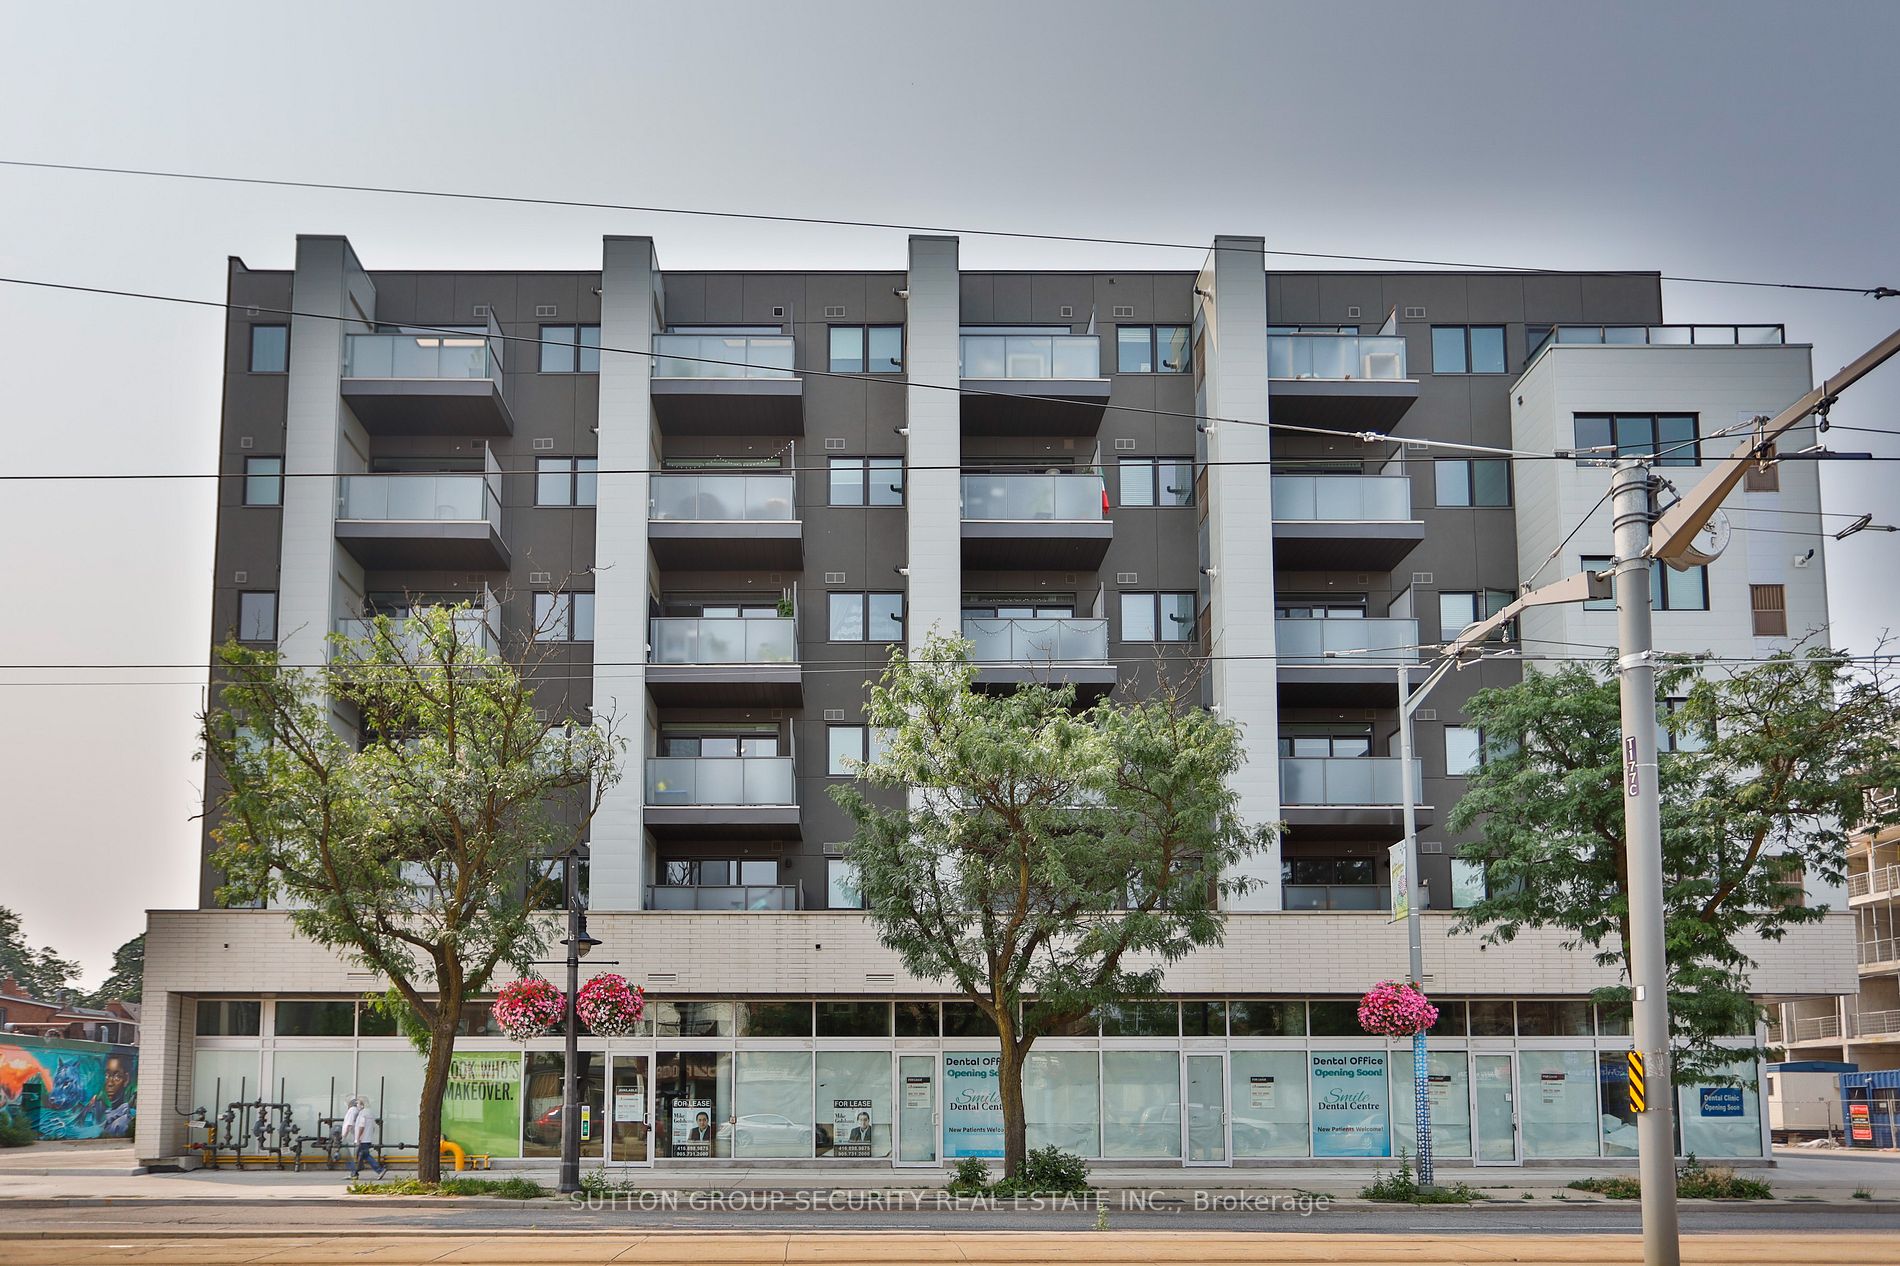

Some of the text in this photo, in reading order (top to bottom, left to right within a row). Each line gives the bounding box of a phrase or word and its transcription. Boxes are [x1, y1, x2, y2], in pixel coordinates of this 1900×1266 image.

[1313, 1057, 1384, 1065] Dental Office
[448, 1060, 476, 1080] OOK
[947, 1069, 987, 1079] Opening
[1314, 1068, 1382, 1078] Opening Soon!
[444, 1082, 514, 1100] MAKEOVER.
[1324, 1088, 1370, 1104] Smile
[950, 1102, 1003, 1110] Dental Cent
[1318, 1102, 1380, 1110] Dental Centre
